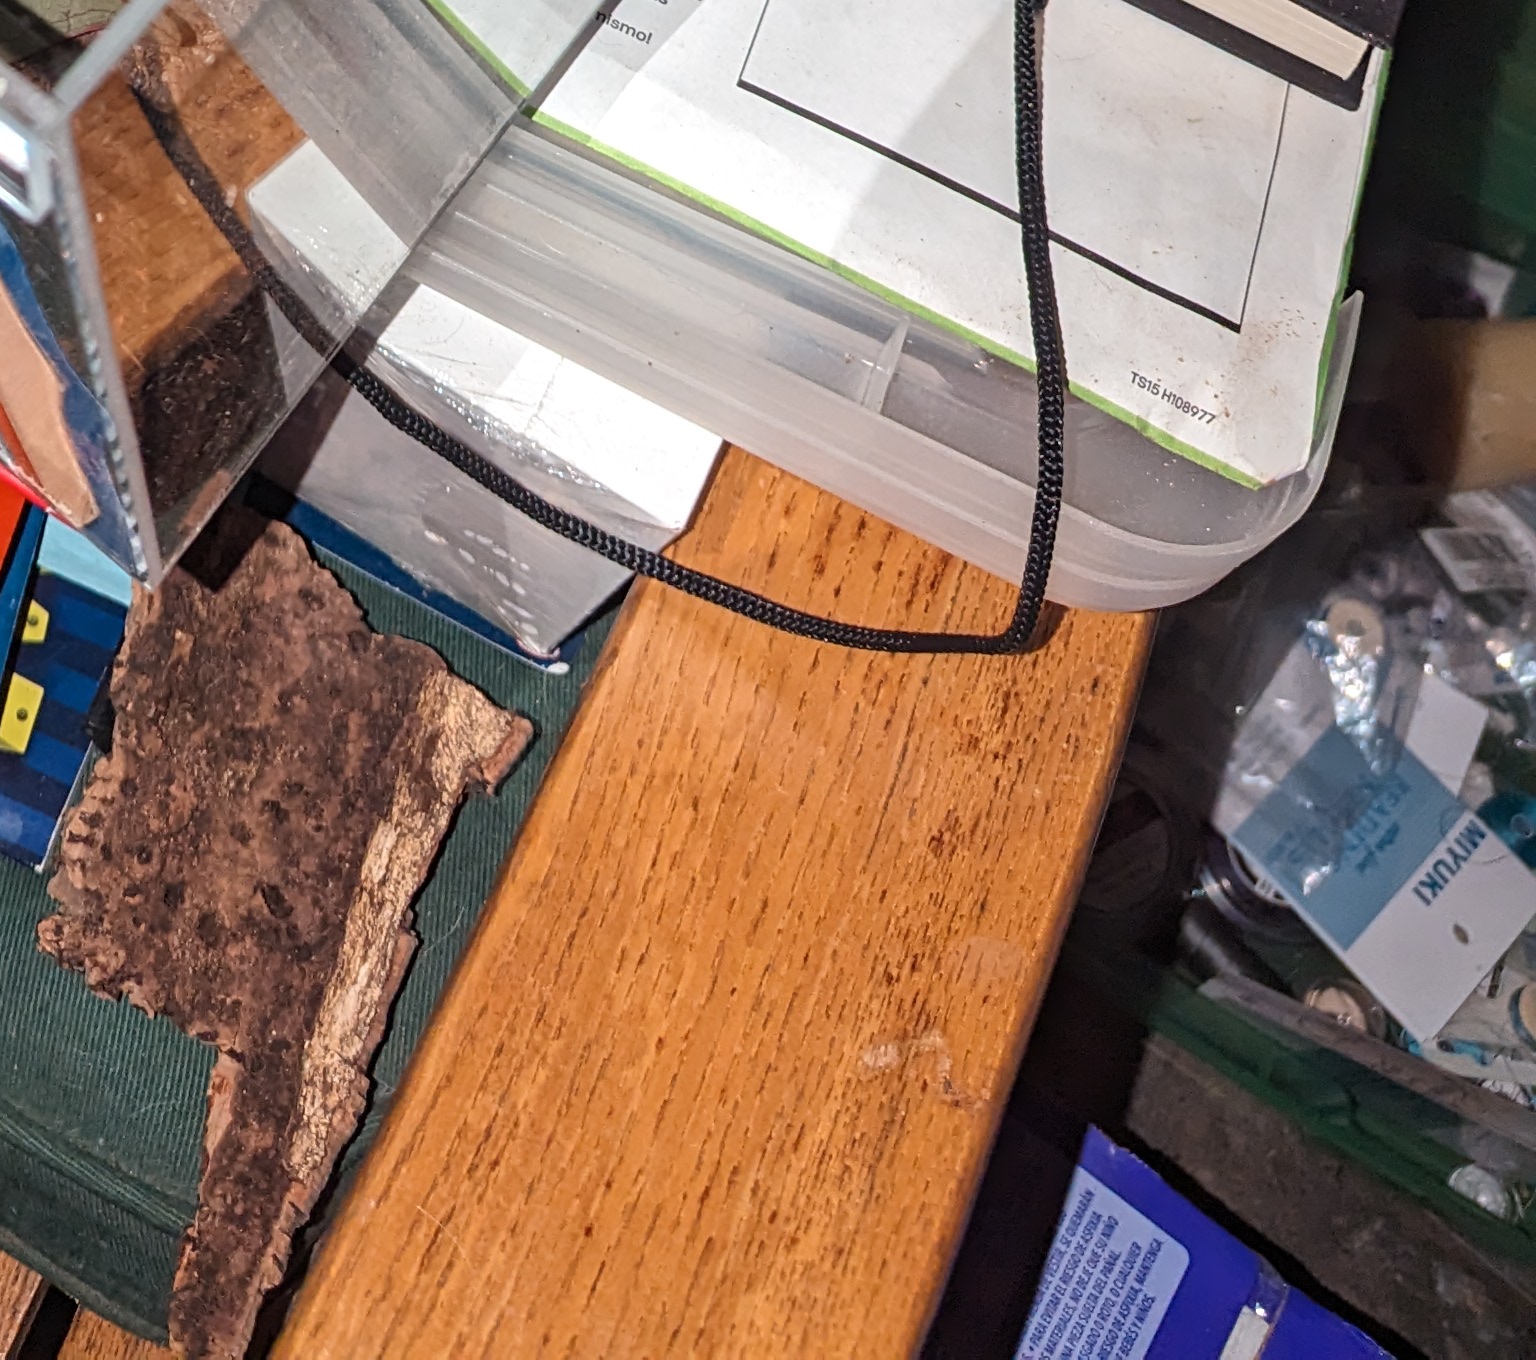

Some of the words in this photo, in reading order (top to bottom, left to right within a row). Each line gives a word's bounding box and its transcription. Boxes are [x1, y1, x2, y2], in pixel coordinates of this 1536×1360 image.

[1130, 370, 1161, 396] TS15
[1161, 388, 1216, 425] H108977
[1412, 819, 1487, 906] MIYUKI
[1039, 1292, 1062, 1324] EVITAR
[1058, 1252, 1082, 1286] RIESGO
[1068, 1286, 1083, 1304] NO
[1085, 1248, 1102, 1270] QUE
[1066, 1320, 1085, 1347] PIEZA
